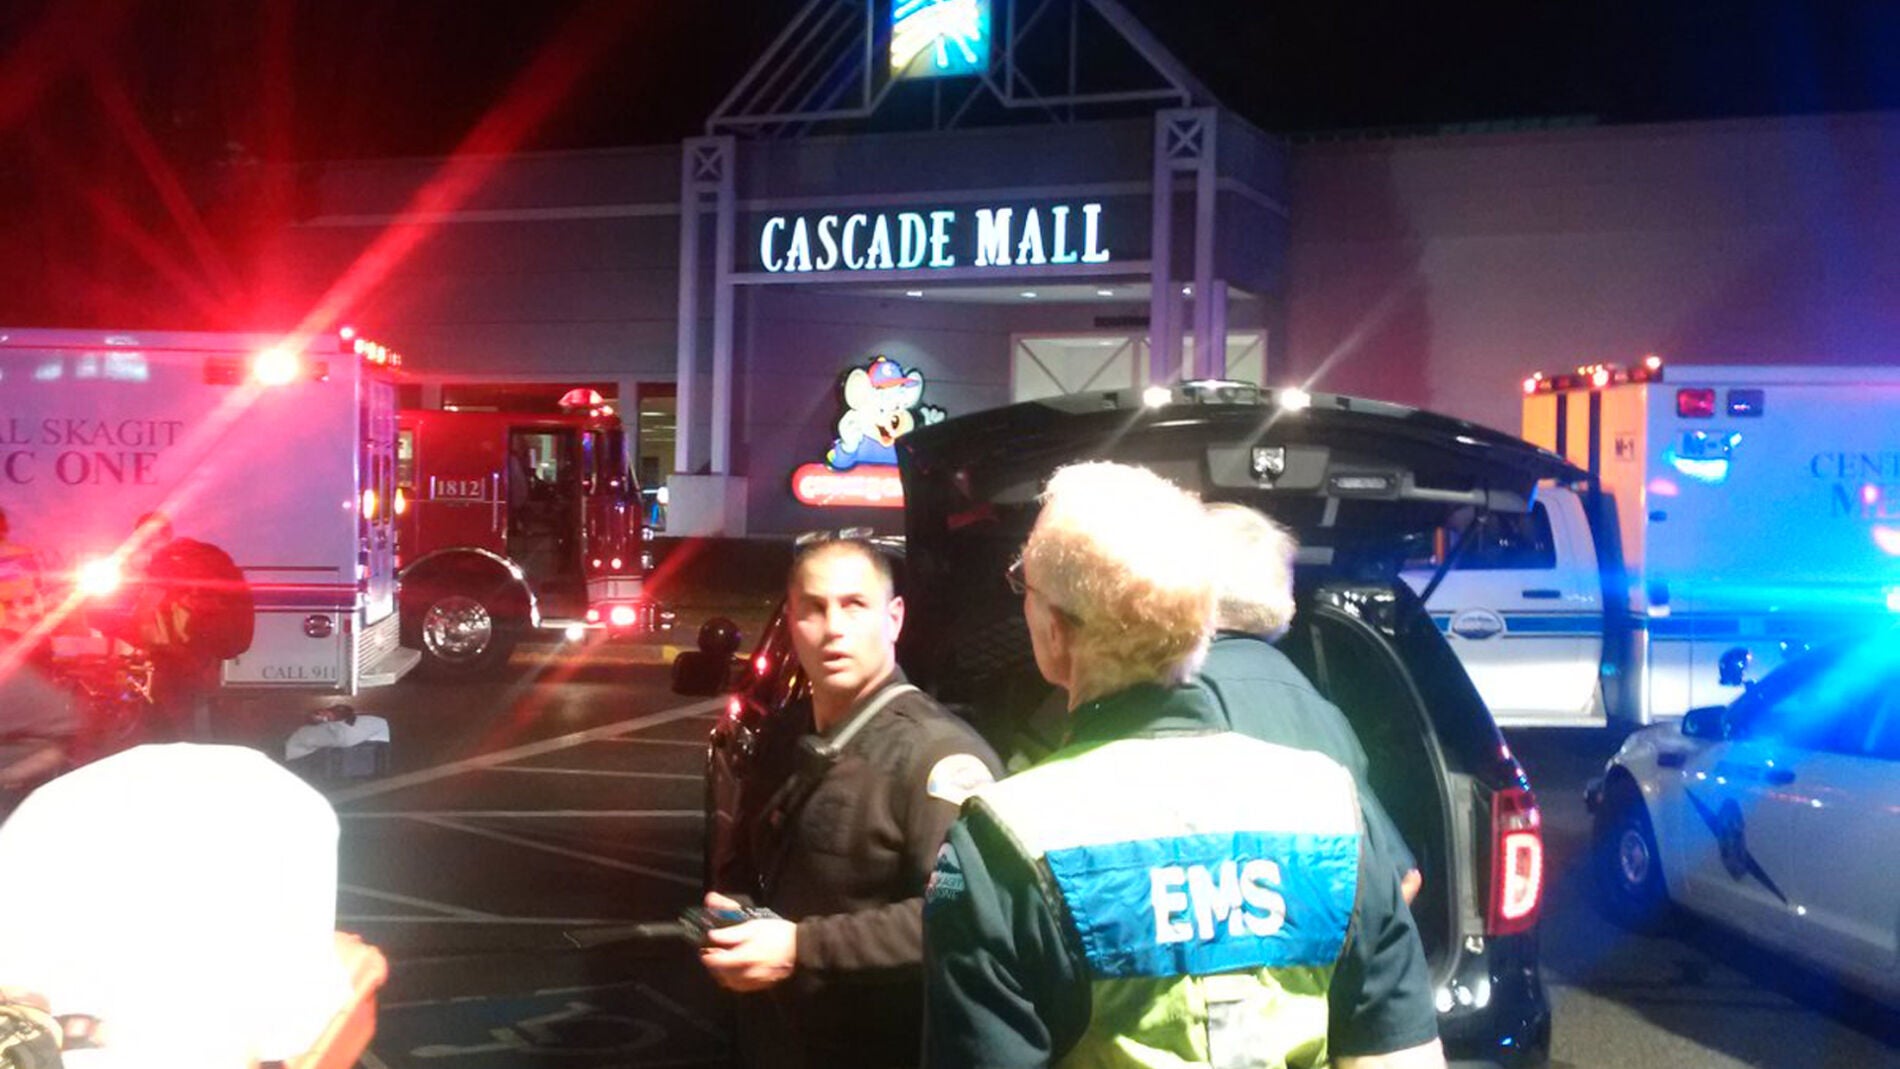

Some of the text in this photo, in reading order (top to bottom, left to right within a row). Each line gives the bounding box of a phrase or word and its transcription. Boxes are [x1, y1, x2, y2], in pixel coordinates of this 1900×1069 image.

[760, 203, 1110, 272] CASCADE MALL
[42, 418, 183, 446] SKAGIT
[55, 450, 158, 485] ONE
[437, 480, 480, 496] 1812
[262, 665, 337, 679] CALL 911
[1150, 858, 1287, 944] EMS
